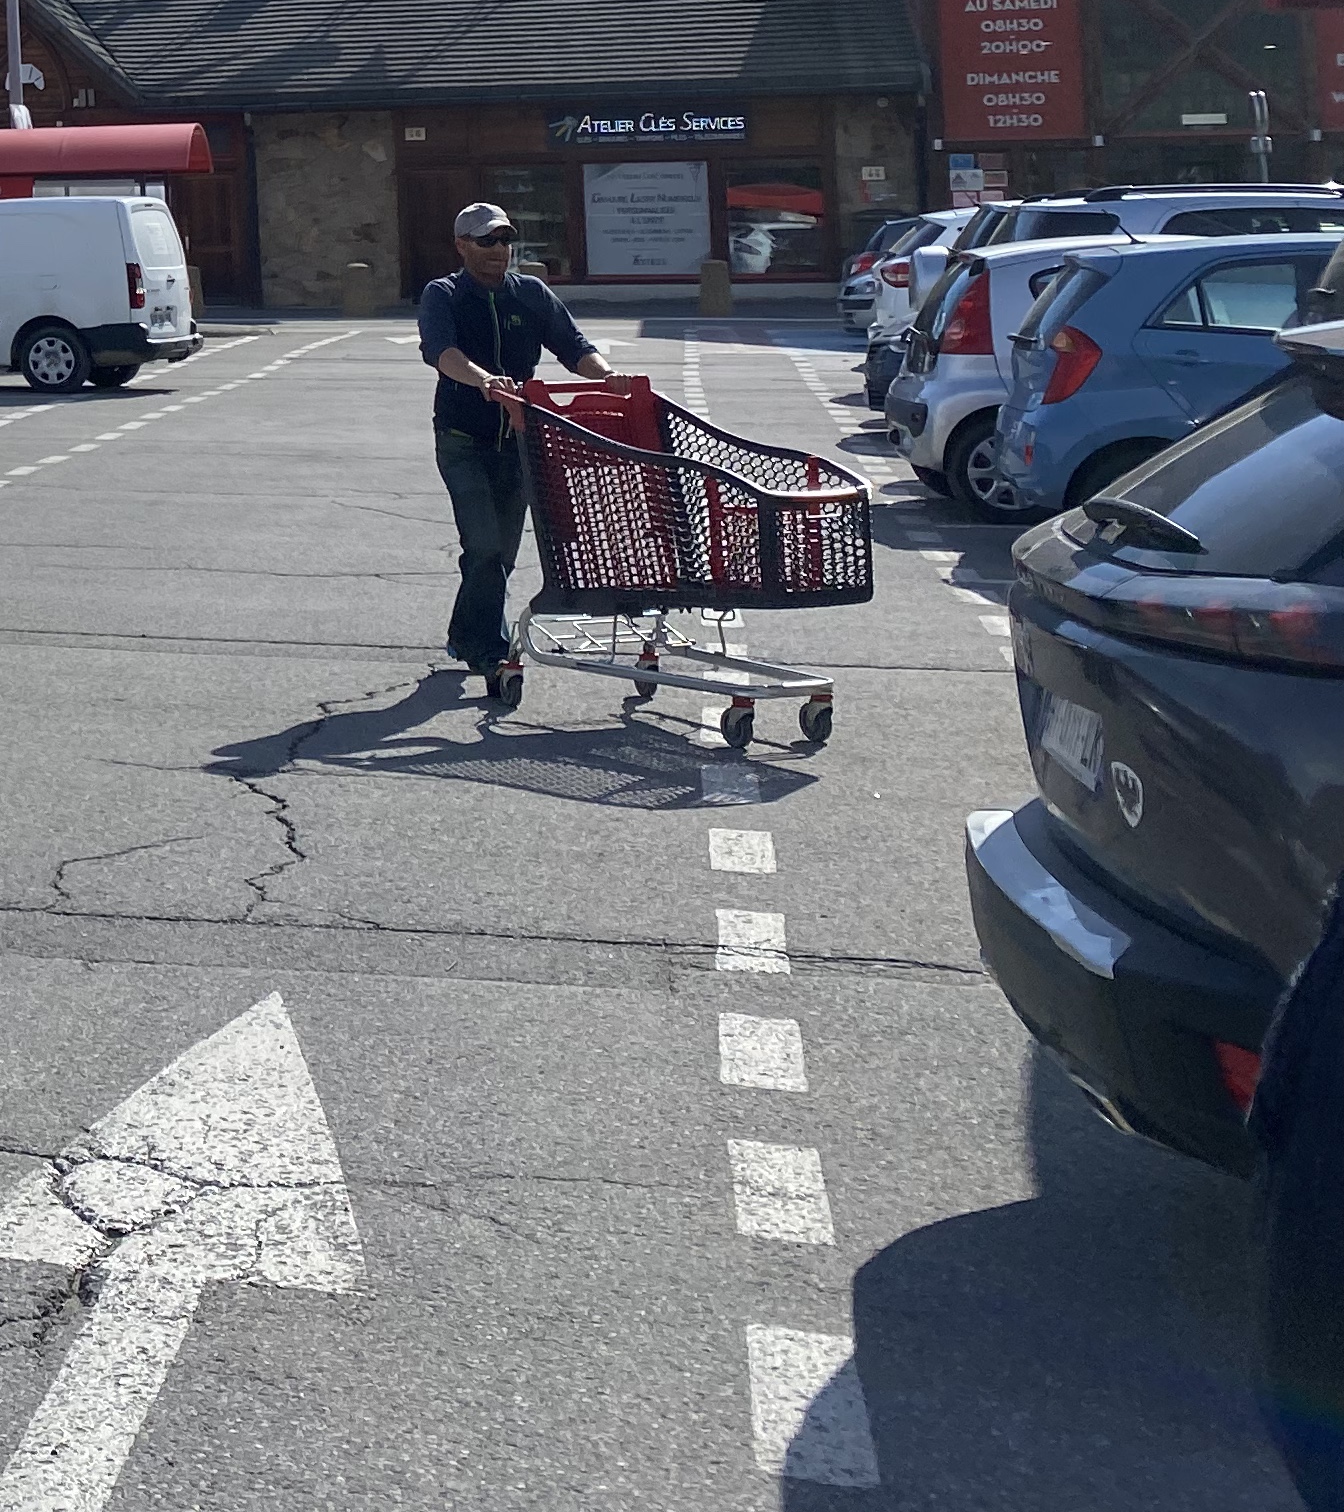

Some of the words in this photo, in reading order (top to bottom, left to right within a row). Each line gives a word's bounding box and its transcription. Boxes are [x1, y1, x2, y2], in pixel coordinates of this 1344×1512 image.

[965, 0, 987, 12] AU
[980, 19, 1043, 32] 08H30
[980, 40, 1046, 54] 20H00
[967, 71, 1060, 85] DIMANCHE
[983, 93, 1046, 106] 08H30
[577, 115, 634, 133] ATELIER
[680, 112, 745, 131] SERVICES
[987, 114, 1043, 127] 12H30
